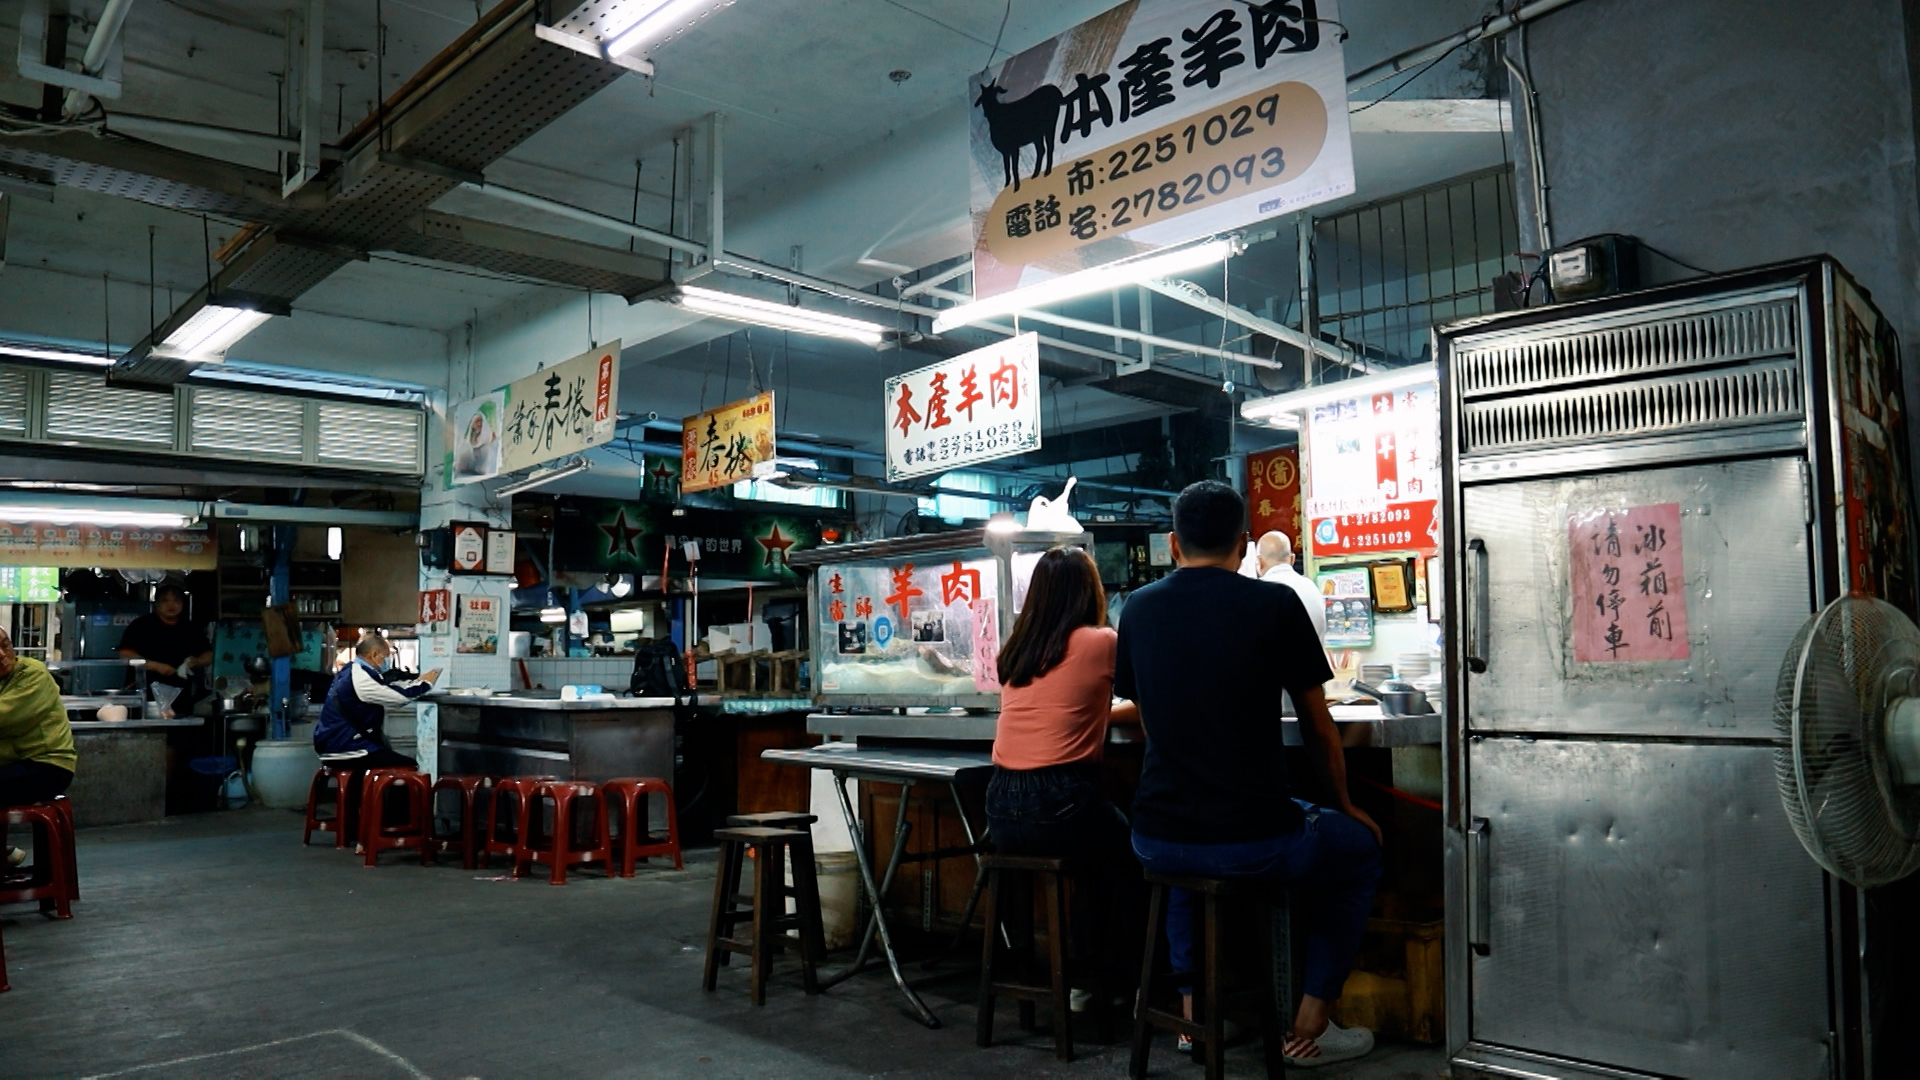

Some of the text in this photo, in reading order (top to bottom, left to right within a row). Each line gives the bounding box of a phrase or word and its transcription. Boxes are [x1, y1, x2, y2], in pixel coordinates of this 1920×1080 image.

[1060, 0, 1320, 143] 本產羊肉
[1006, 194, 1061, 238] 電話
[893, 356, 1018, 438] 本產羊肉
[421, 591, 447, 623] 春捲
[885, 561, 981, 618] 羊肉
[1591, 517, 1630, 659] 請勿停車
